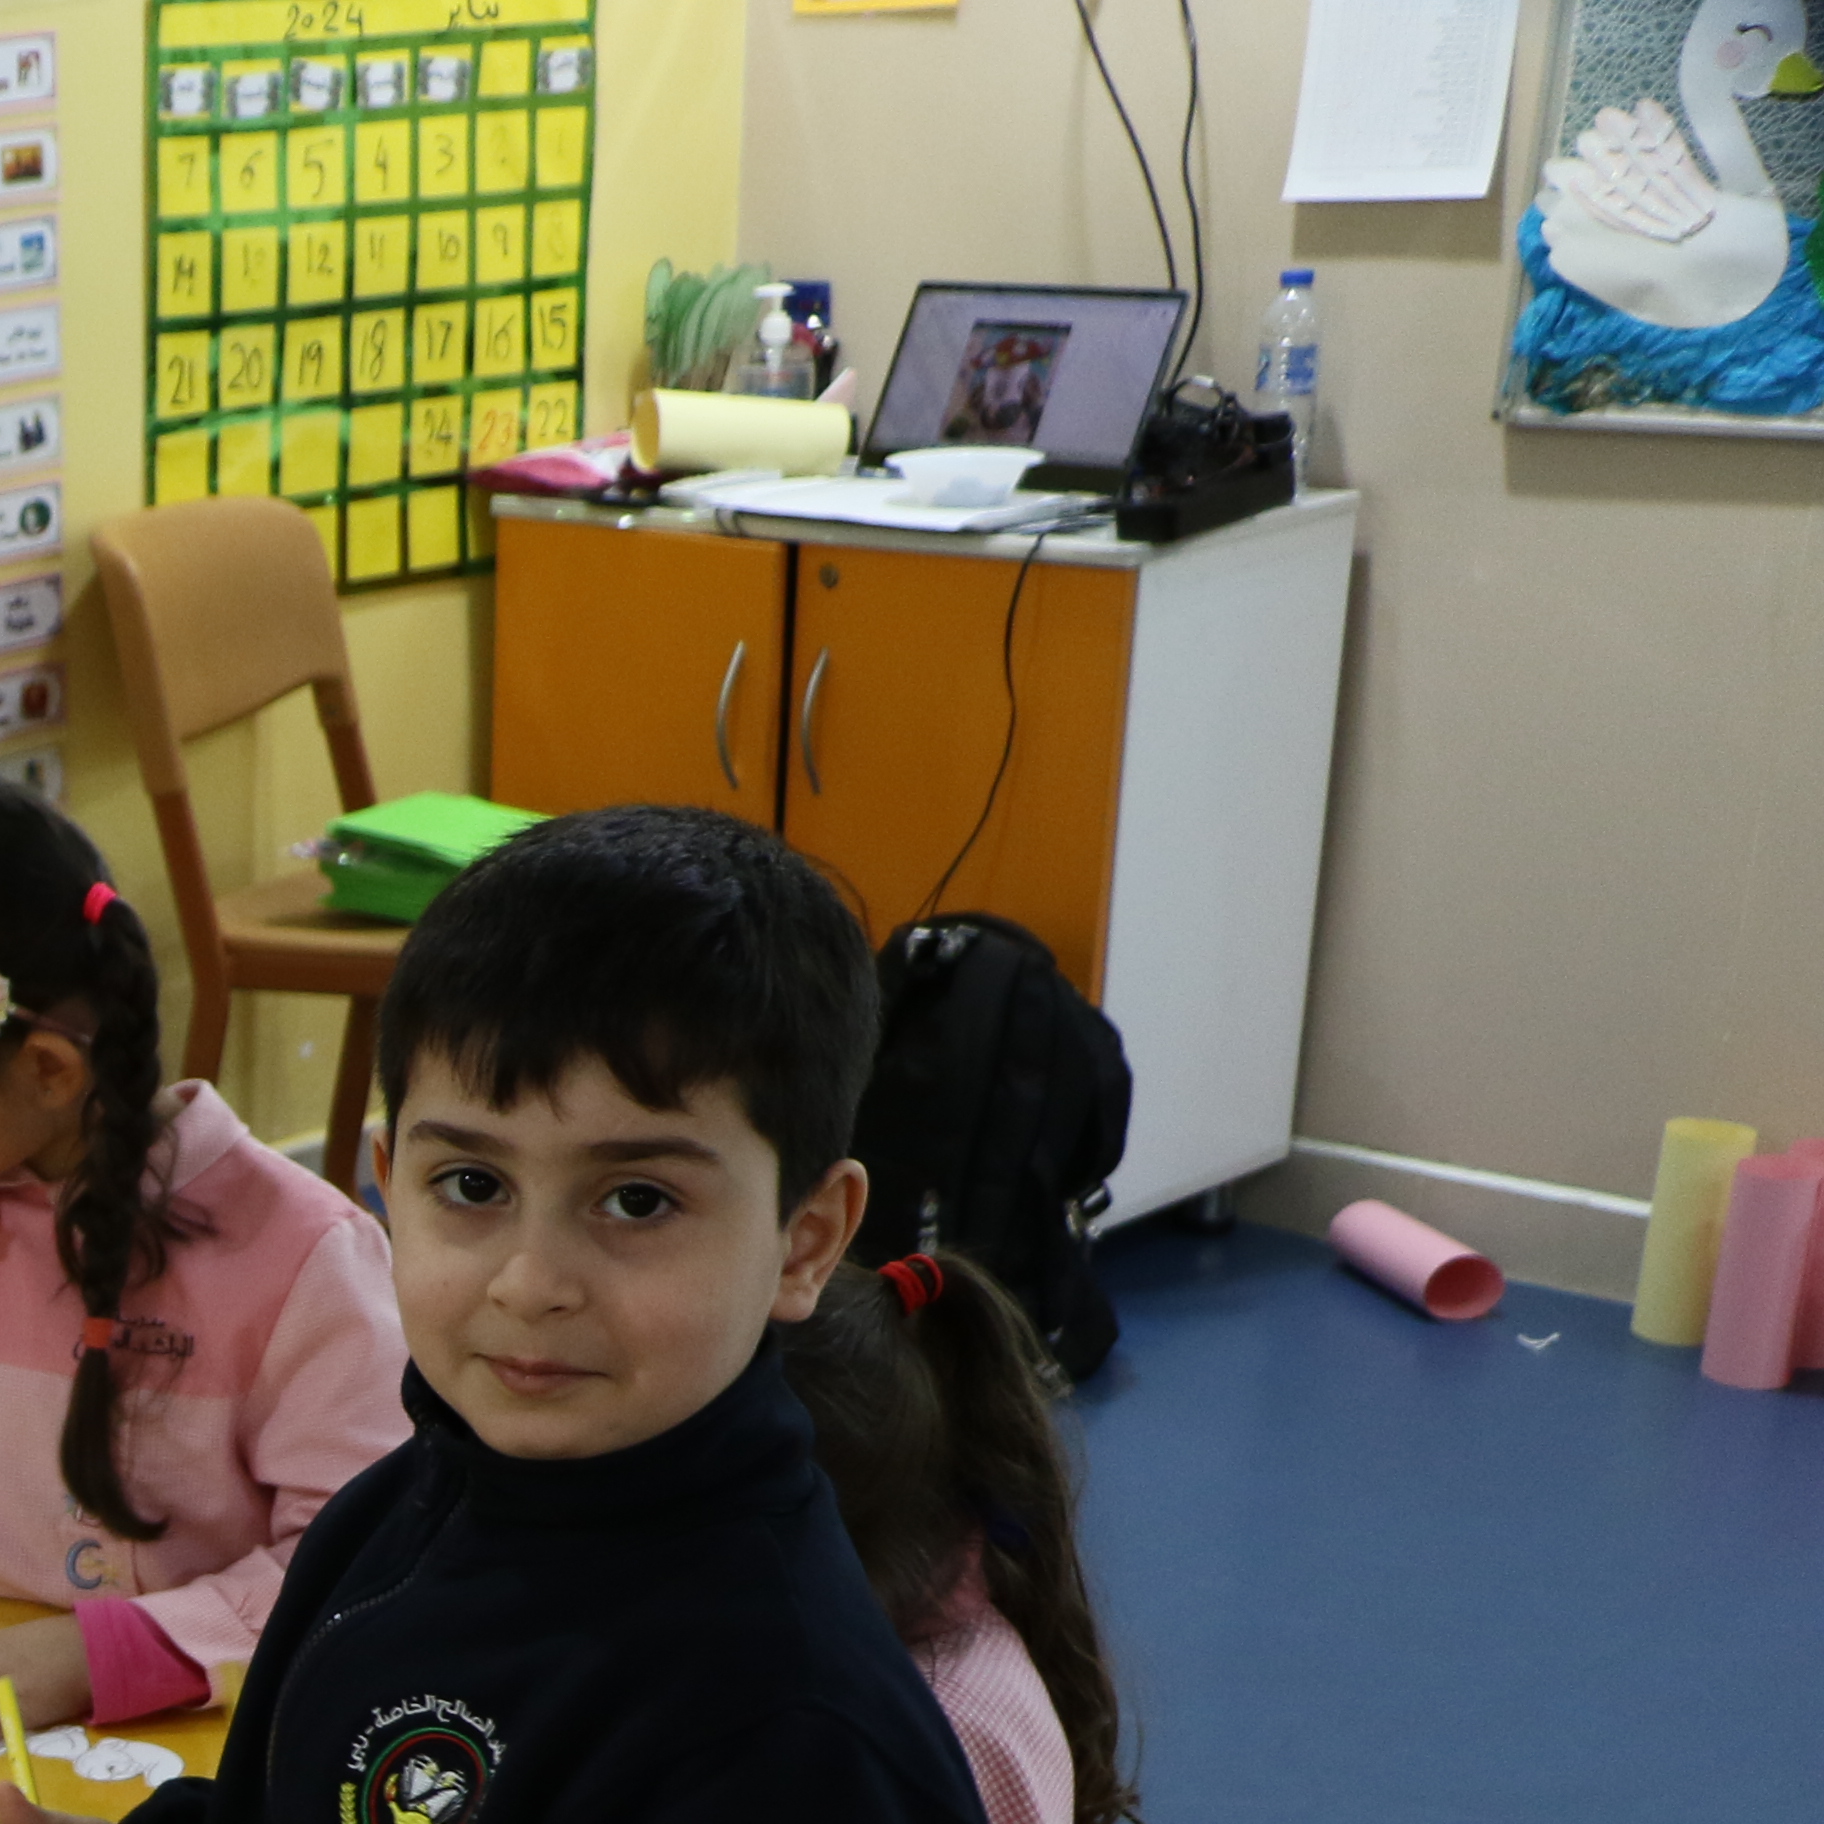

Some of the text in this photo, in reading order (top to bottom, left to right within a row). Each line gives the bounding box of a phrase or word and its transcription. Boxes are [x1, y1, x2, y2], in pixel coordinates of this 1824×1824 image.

[283, 0, 364, 42] 2024
[177, 152, 196, 188] 7
[238, 149, 264, 190] 6
[302, 138, 334, 199] 5
[373, 134, 389, 192] 4
[435, 133, 454, 177] 3
[305, 232, 334, 275] 12
[437, 228, 462, 262] 10
[491, 221, 510, 258] 9
[172, 253, 196, 296] 14
[168, 303, 568, 406] 15 16 17 18 19 20 21
[477, 408, 516, 450] 23
[535, 399, 569, 438] 22
